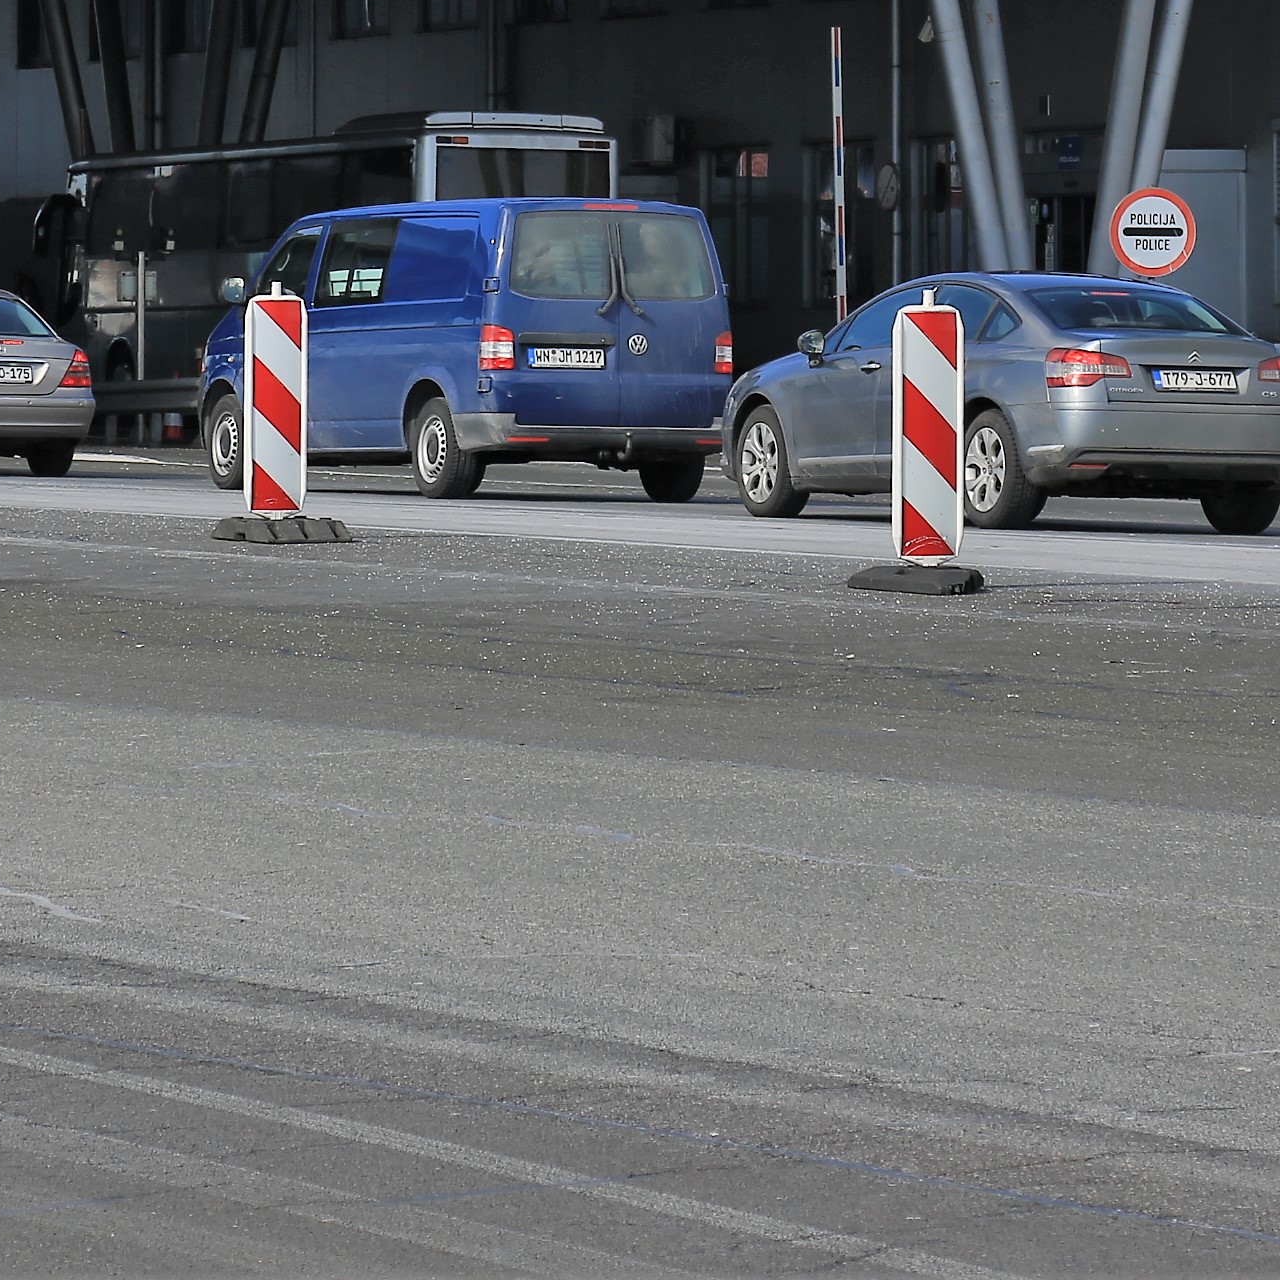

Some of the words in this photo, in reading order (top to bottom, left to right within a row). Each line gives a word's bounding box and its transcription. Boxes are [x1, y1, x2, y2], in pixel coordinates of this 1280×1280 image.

[1130, 213, 1176, 225] POLICIJA
[1135, 239, 1170, 251] POLICE
[535, 350, 550, 362] WN
[558, 350, 572, 362] JM
[575, 350, 602, 363] 1217
[1163, 372, 1232, 386] T79-J-677
[1261, 390, 1278, 398] C5
